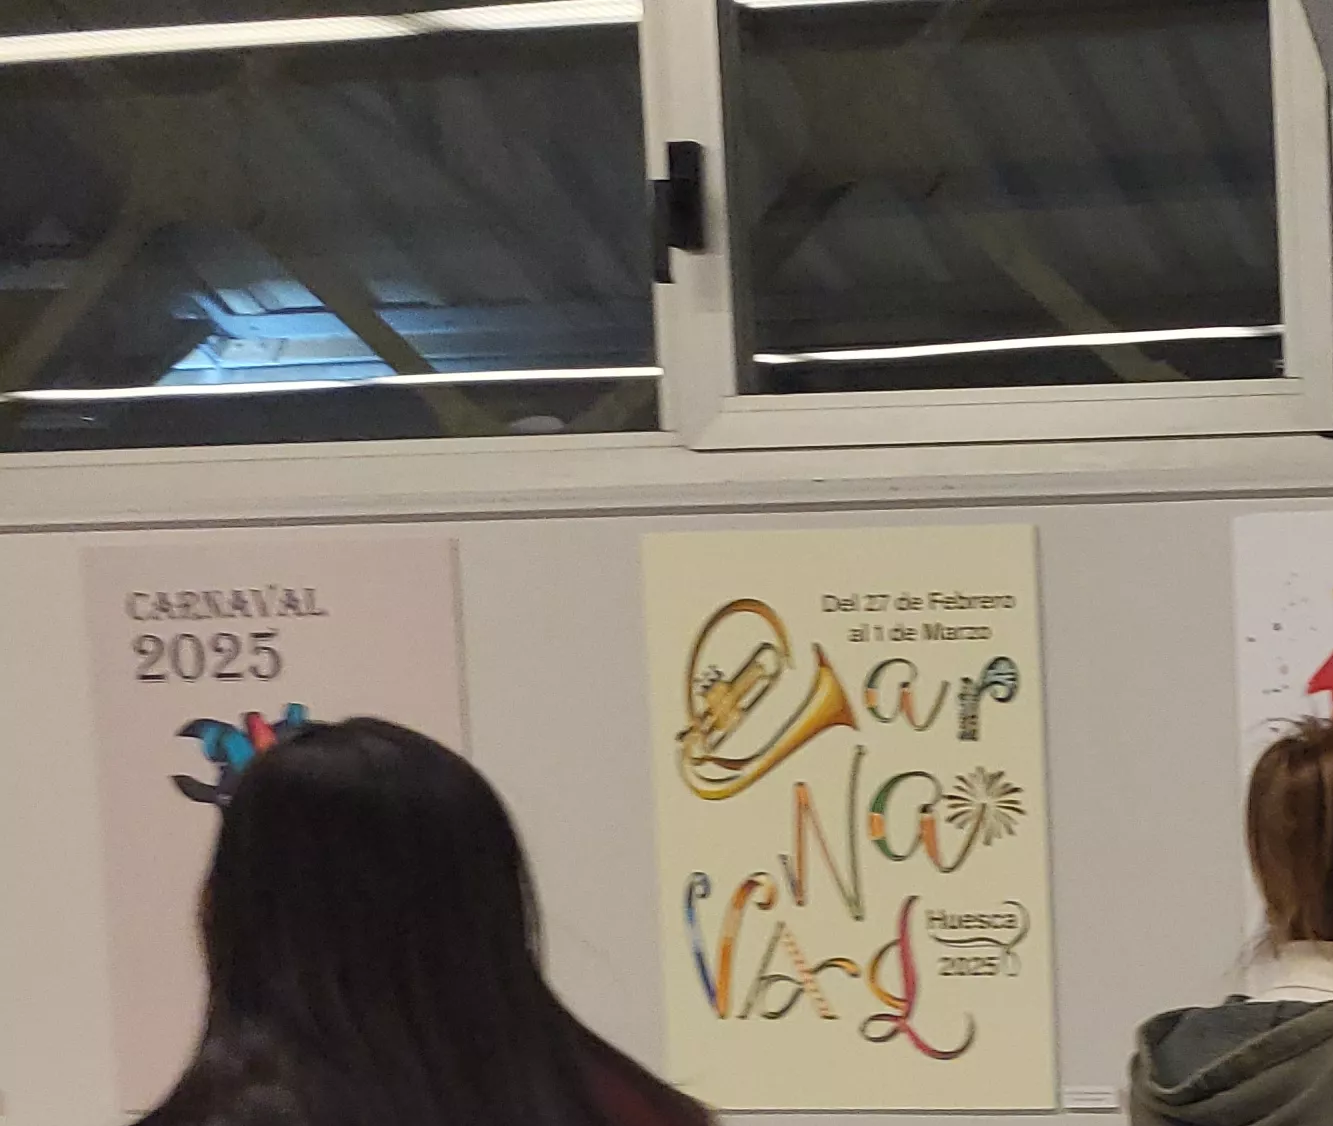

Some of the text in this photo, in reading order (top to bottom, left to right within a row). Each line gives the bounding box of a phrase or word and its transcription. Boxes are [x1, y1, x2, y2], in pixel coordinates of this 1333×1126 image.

[125, 586, 329, 620] CARNAVAL
[821, 594, 860, 613] Del
[894, 591, 924, 611] de
[928, 591, 1018, 611] Febrero
[889, 623, 919, 641] de
[922, 622, 993, 641] Marzo
[131, 629, 283, 682] 2025
[925, 909, 1021, 930] Huesca
[937, 956, 1000, 977] 2025
